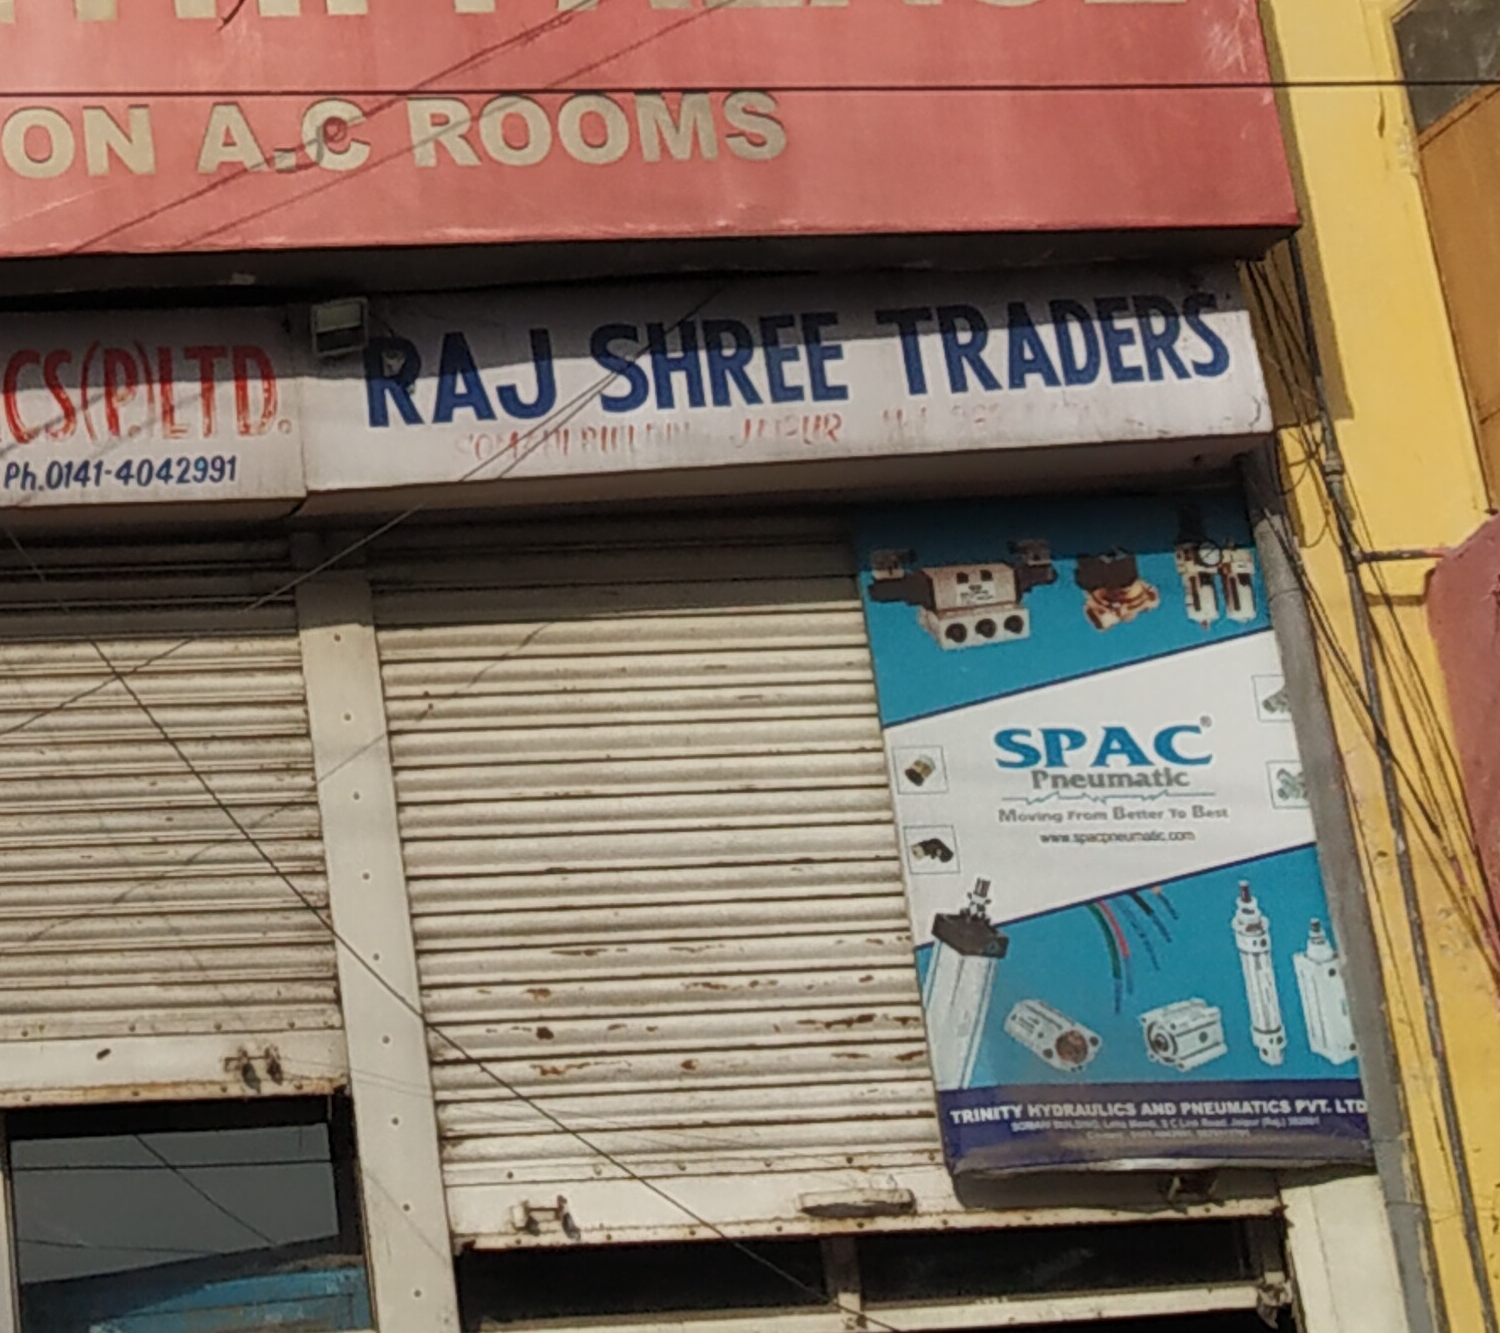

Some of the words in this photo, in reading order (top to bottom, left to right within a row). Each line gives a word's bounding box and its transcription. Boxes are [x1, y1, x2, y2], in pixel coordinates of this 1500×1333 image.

[197, 98, 372, 175] A.C
[403, 88, 790, 167] ROOMS
[362, 327, 558, 429] RAJ
[589, 311, 849, 413] SHREE
[876, 293, 1232, 396] TRADERS
[993, 724, 1214, 769] SPAC
[1031, 767, 1191, 790] Pneumatic
[950, 1103, 1023, 1124] TRINITY
[1027, 1101, 1137, 1119] HYDRAULICS
[1141, 1102, 1177, 1116] AND
[1180, 1098, 1292, 1116] PNEUMATICS
